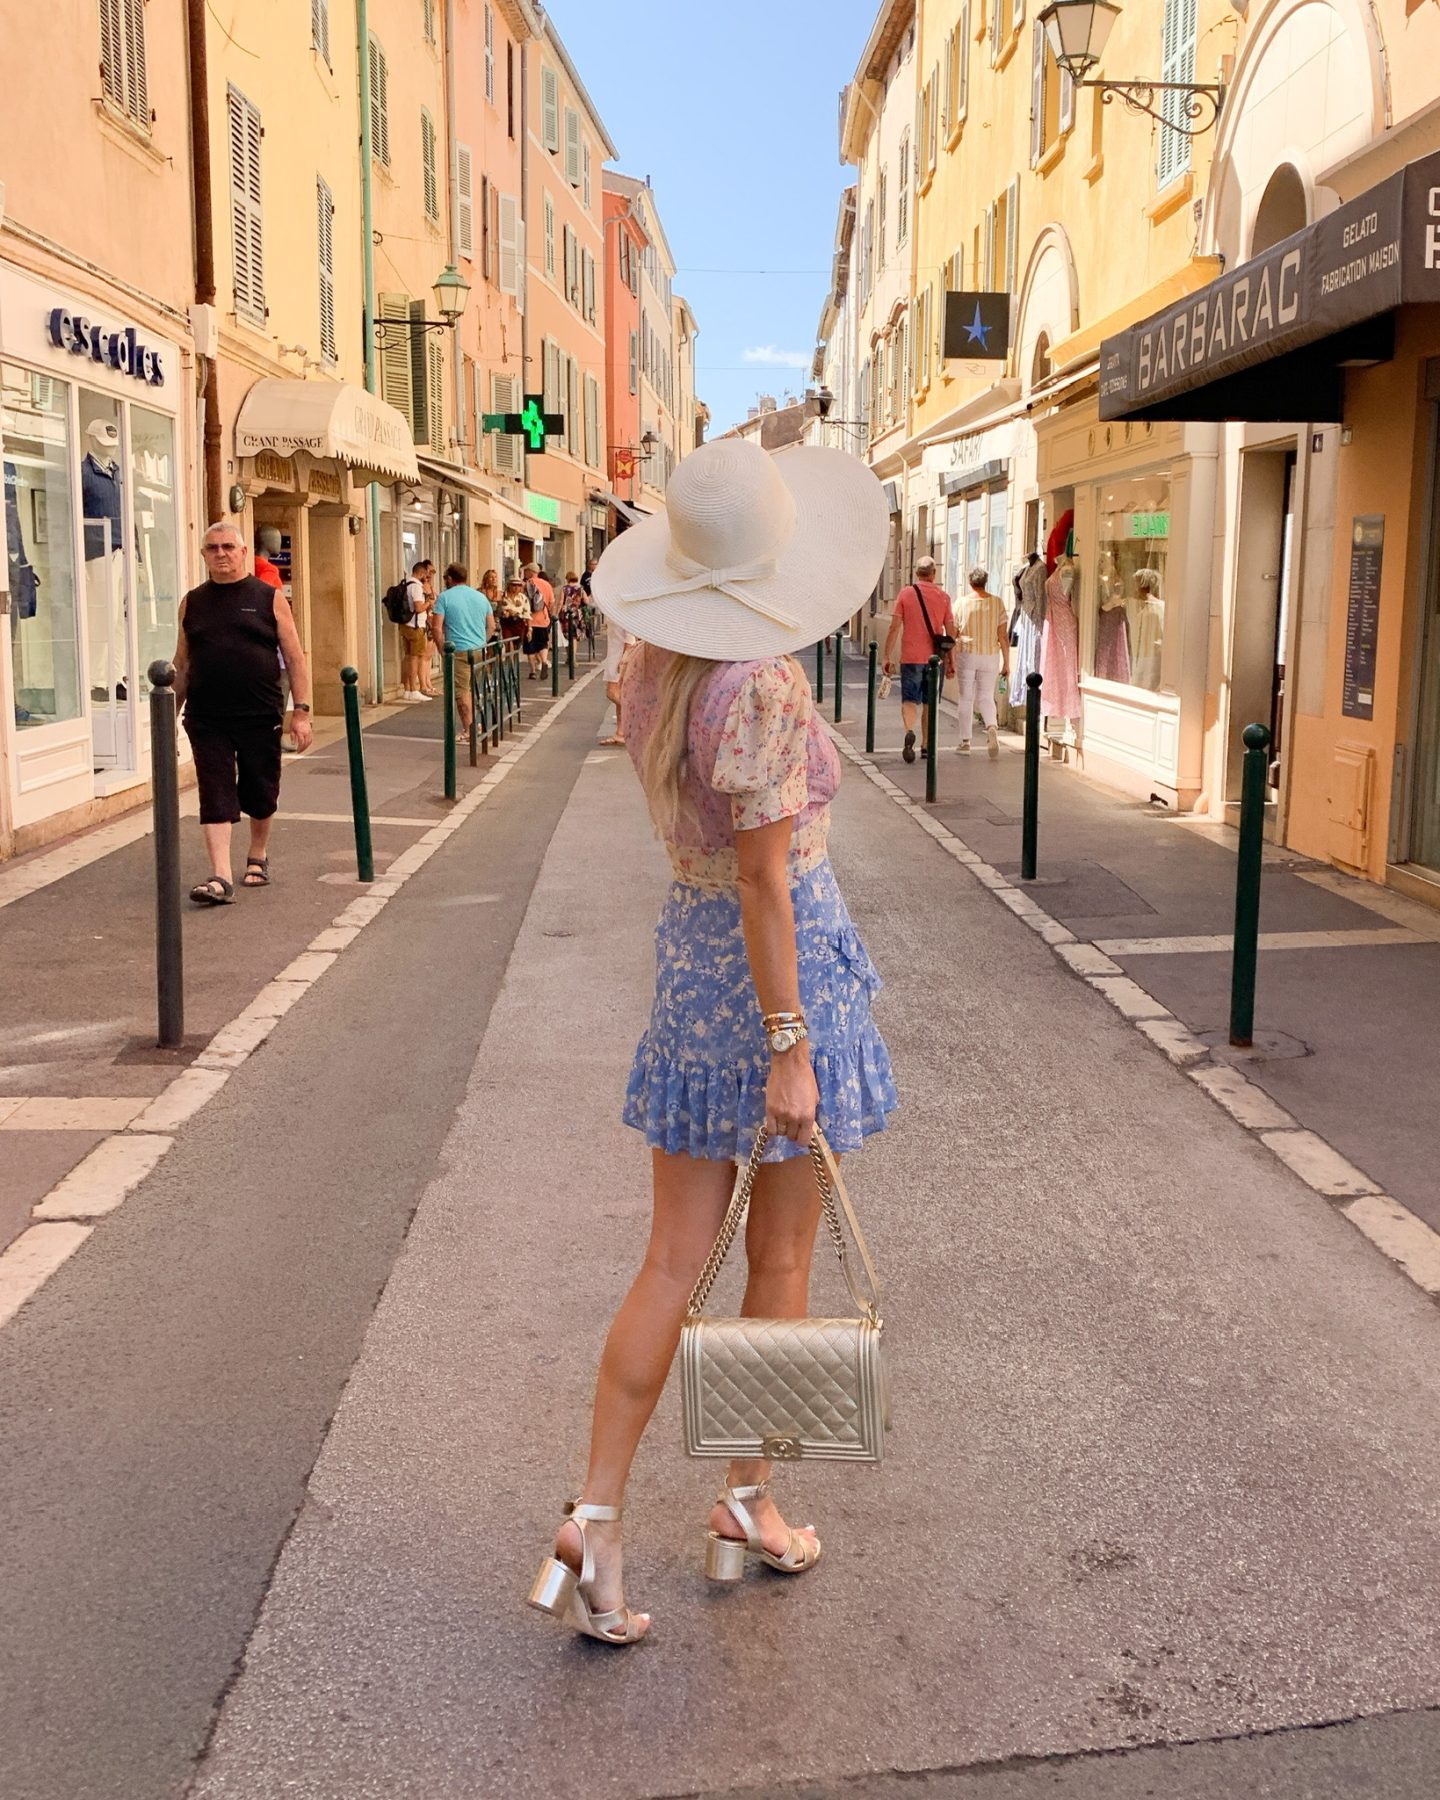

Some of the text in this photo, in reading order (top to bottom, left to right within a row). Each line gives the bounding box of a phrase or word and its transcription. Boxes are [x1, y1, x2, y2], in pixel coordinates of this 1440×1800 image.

[1343, 212, 1378, 248] GELATO
[1321, 256, 1367, 296] FABRICATION
[1369, 240, 1400, 274] MAISON
[1138, 249, 1301, 391] BARBARAC
[48, 307, 165, 387] escales
[243, 435, 324, 449] GRAND PASSAGE
[950, 431, 984, 467] SAFARI
